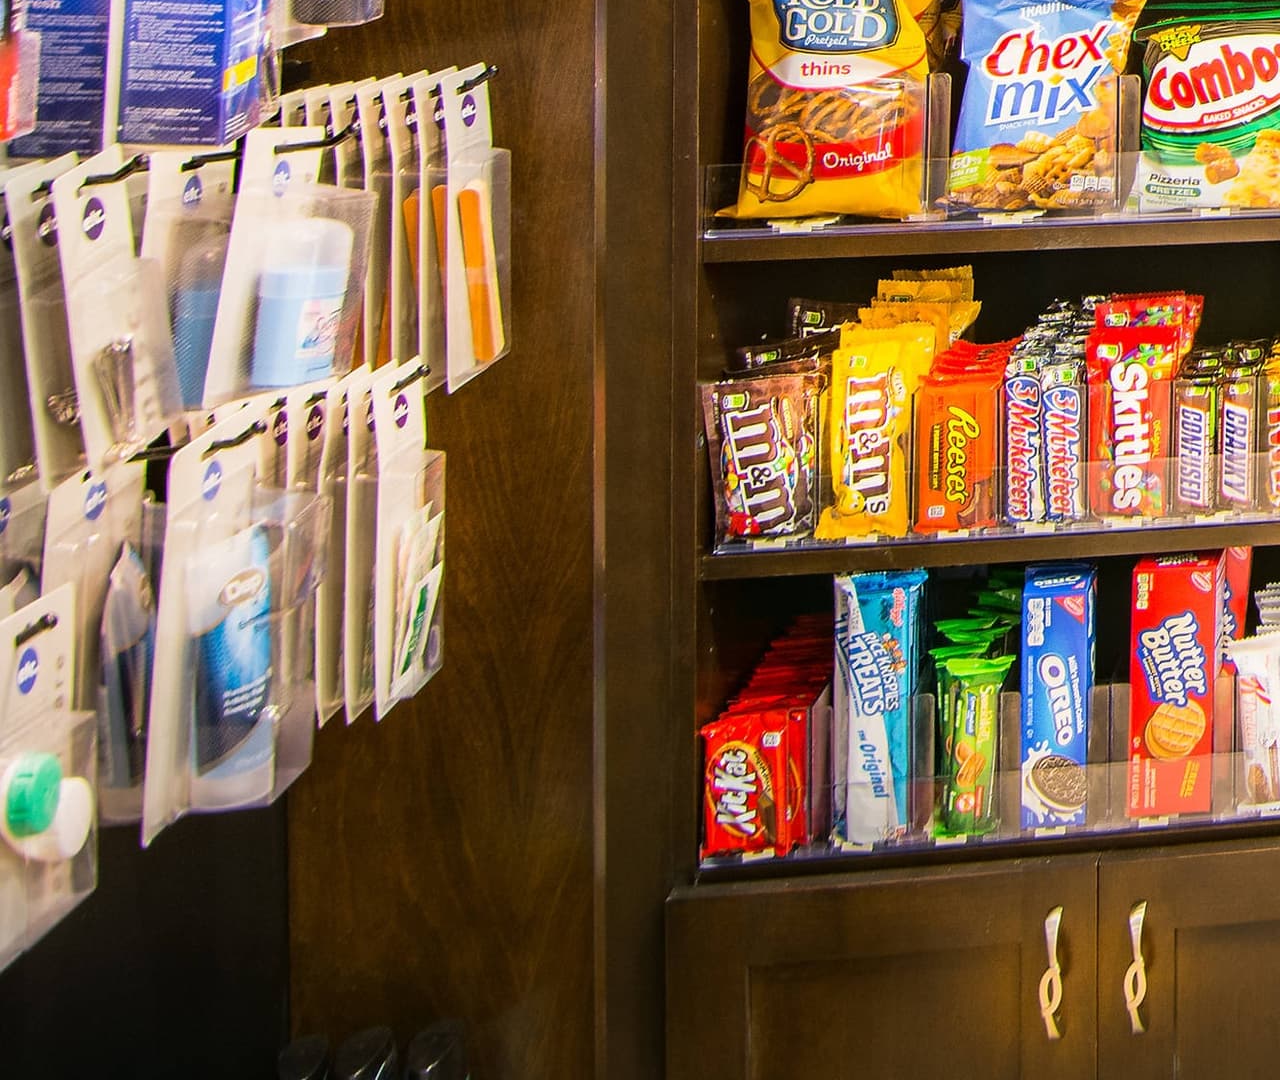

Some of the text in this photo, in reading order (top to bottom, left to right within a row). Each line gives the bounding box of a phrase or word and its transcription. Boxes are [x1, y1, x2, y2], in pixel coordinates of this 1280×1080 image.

[785, 8, 887, 42] GOLD
[805, 34, 848, 47] Pretzels
[986, 25, 1108, 77] Chex
[801, 61, 851, 77] thins
[1203, 97, 1266, 124] BAKED SNACKS
[823, 142, 893, 169] Original
[1150, 173, 1200, 186] Pizzeria
[1150, 186, 1197, 197] PRETZEL
[1053, 392, 1074, 411] 3
[946, 406, 980, 504] Reese's
[1007, 380, 1041, 520] 3 Musketeers
[1111, 361, 1154, 510] Skittles
[1180, 407, 1202, 504] CONFUSED
[1223, 408, 1248, 495] CRANKY
[850, 634, 884, 717] TREATS
[862, 632, 899, 711] RICE KRISPIES
[1141, 627, 1186, 705] Butter
[1165, 612, 1205, 694] Nutter
[1037, 653, 1073, 746] OREO
[860, 743, 889, 799] Original
